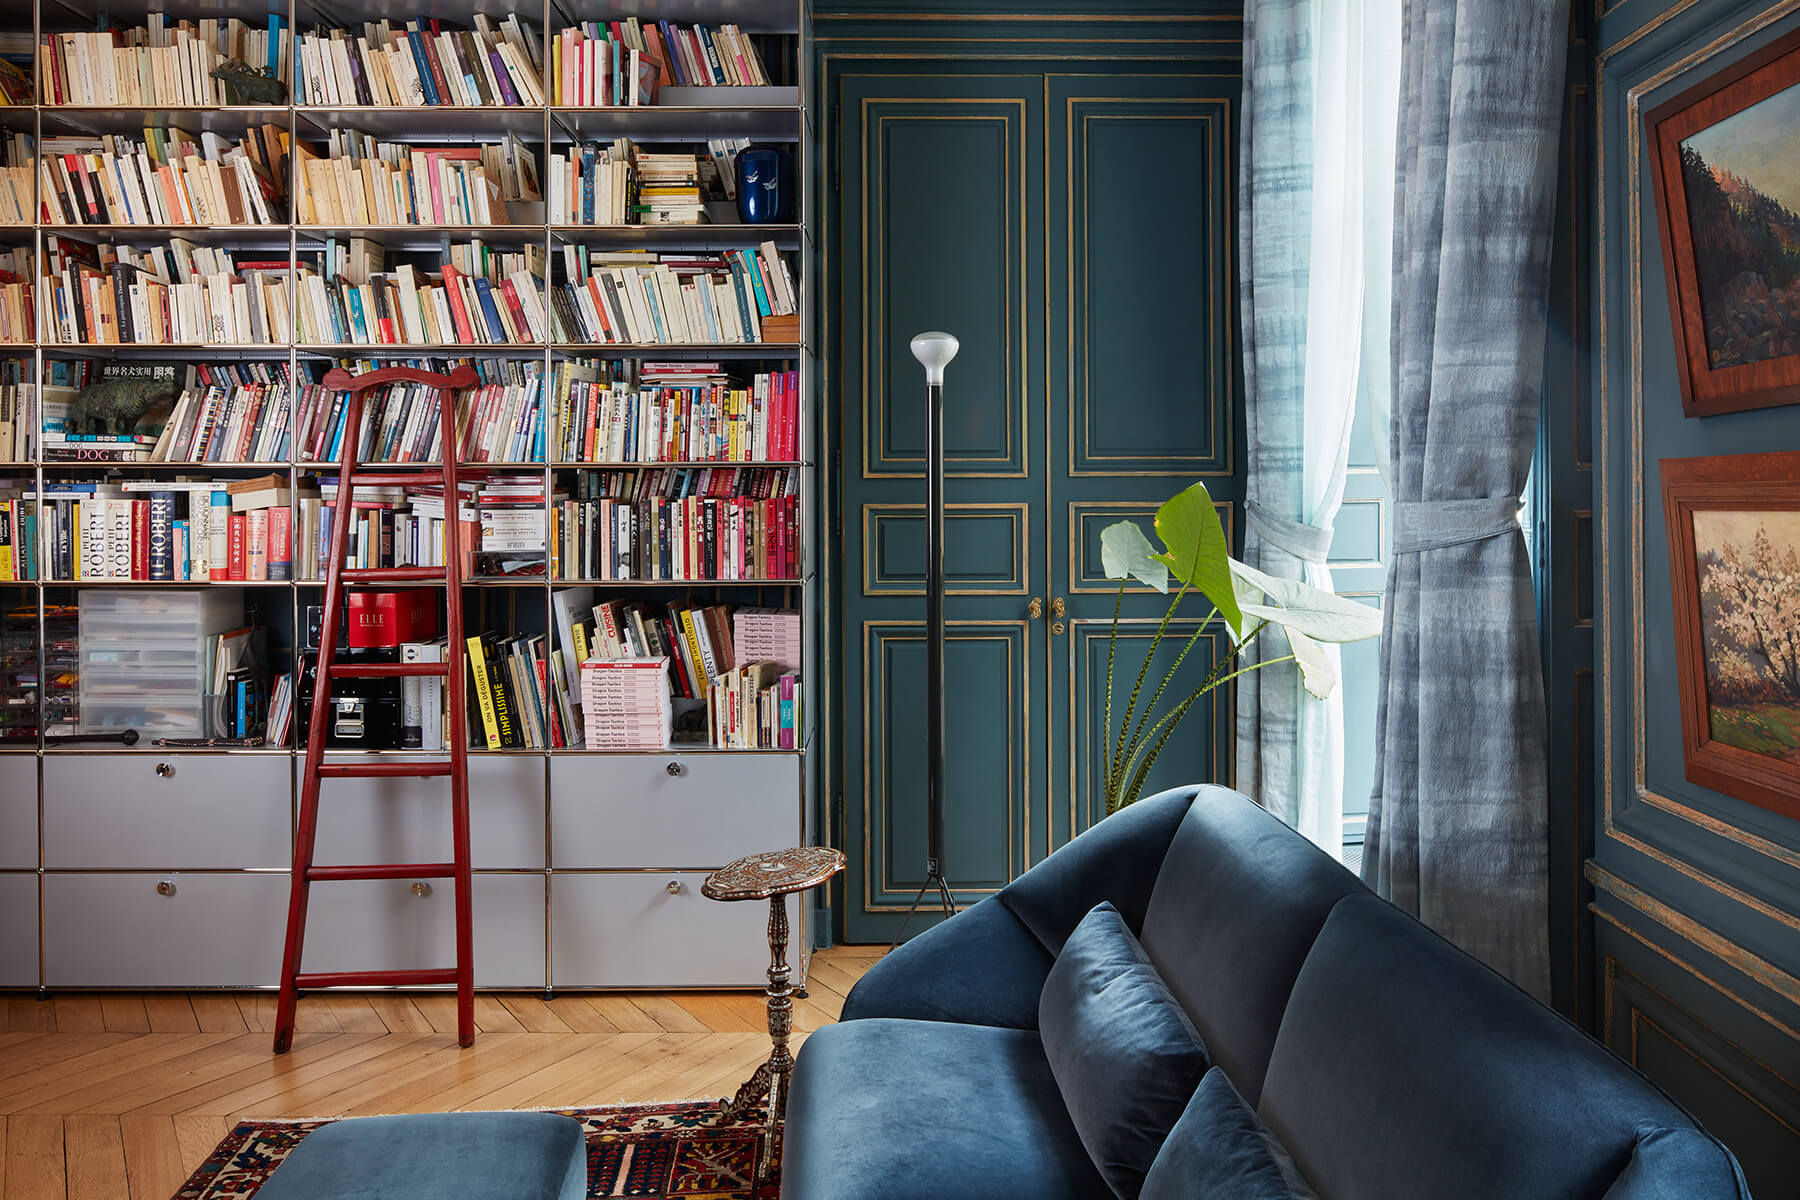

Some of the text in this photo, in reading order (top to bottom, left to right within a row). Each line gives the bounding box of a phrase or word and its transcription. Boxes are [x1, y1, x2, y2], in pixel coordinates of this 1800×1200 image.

[77, 449, 110, 461] DOG
[150, 496, 165, 556] ROBERT
[82, 528, 90, 563] LE PETIT
[90, 512, 104, 577] ROBERT
[108, 554, 115, 563] LE
[115, 512, 130, 577] ROBERT
[150, 559, 165, 576] LE
[360, 613, 384, 624] ELLE
[601, 604, 616, 638] CUISINE
[685, 617, 705, 680] OTTOLENGHI SIMPLE
[703, 650, 717, 683] PLENTY
[483, 701, 490, 712] VA
[484, 713, 492, 723] ON
[493, 683, 512, 736] SIMPLISSIME
